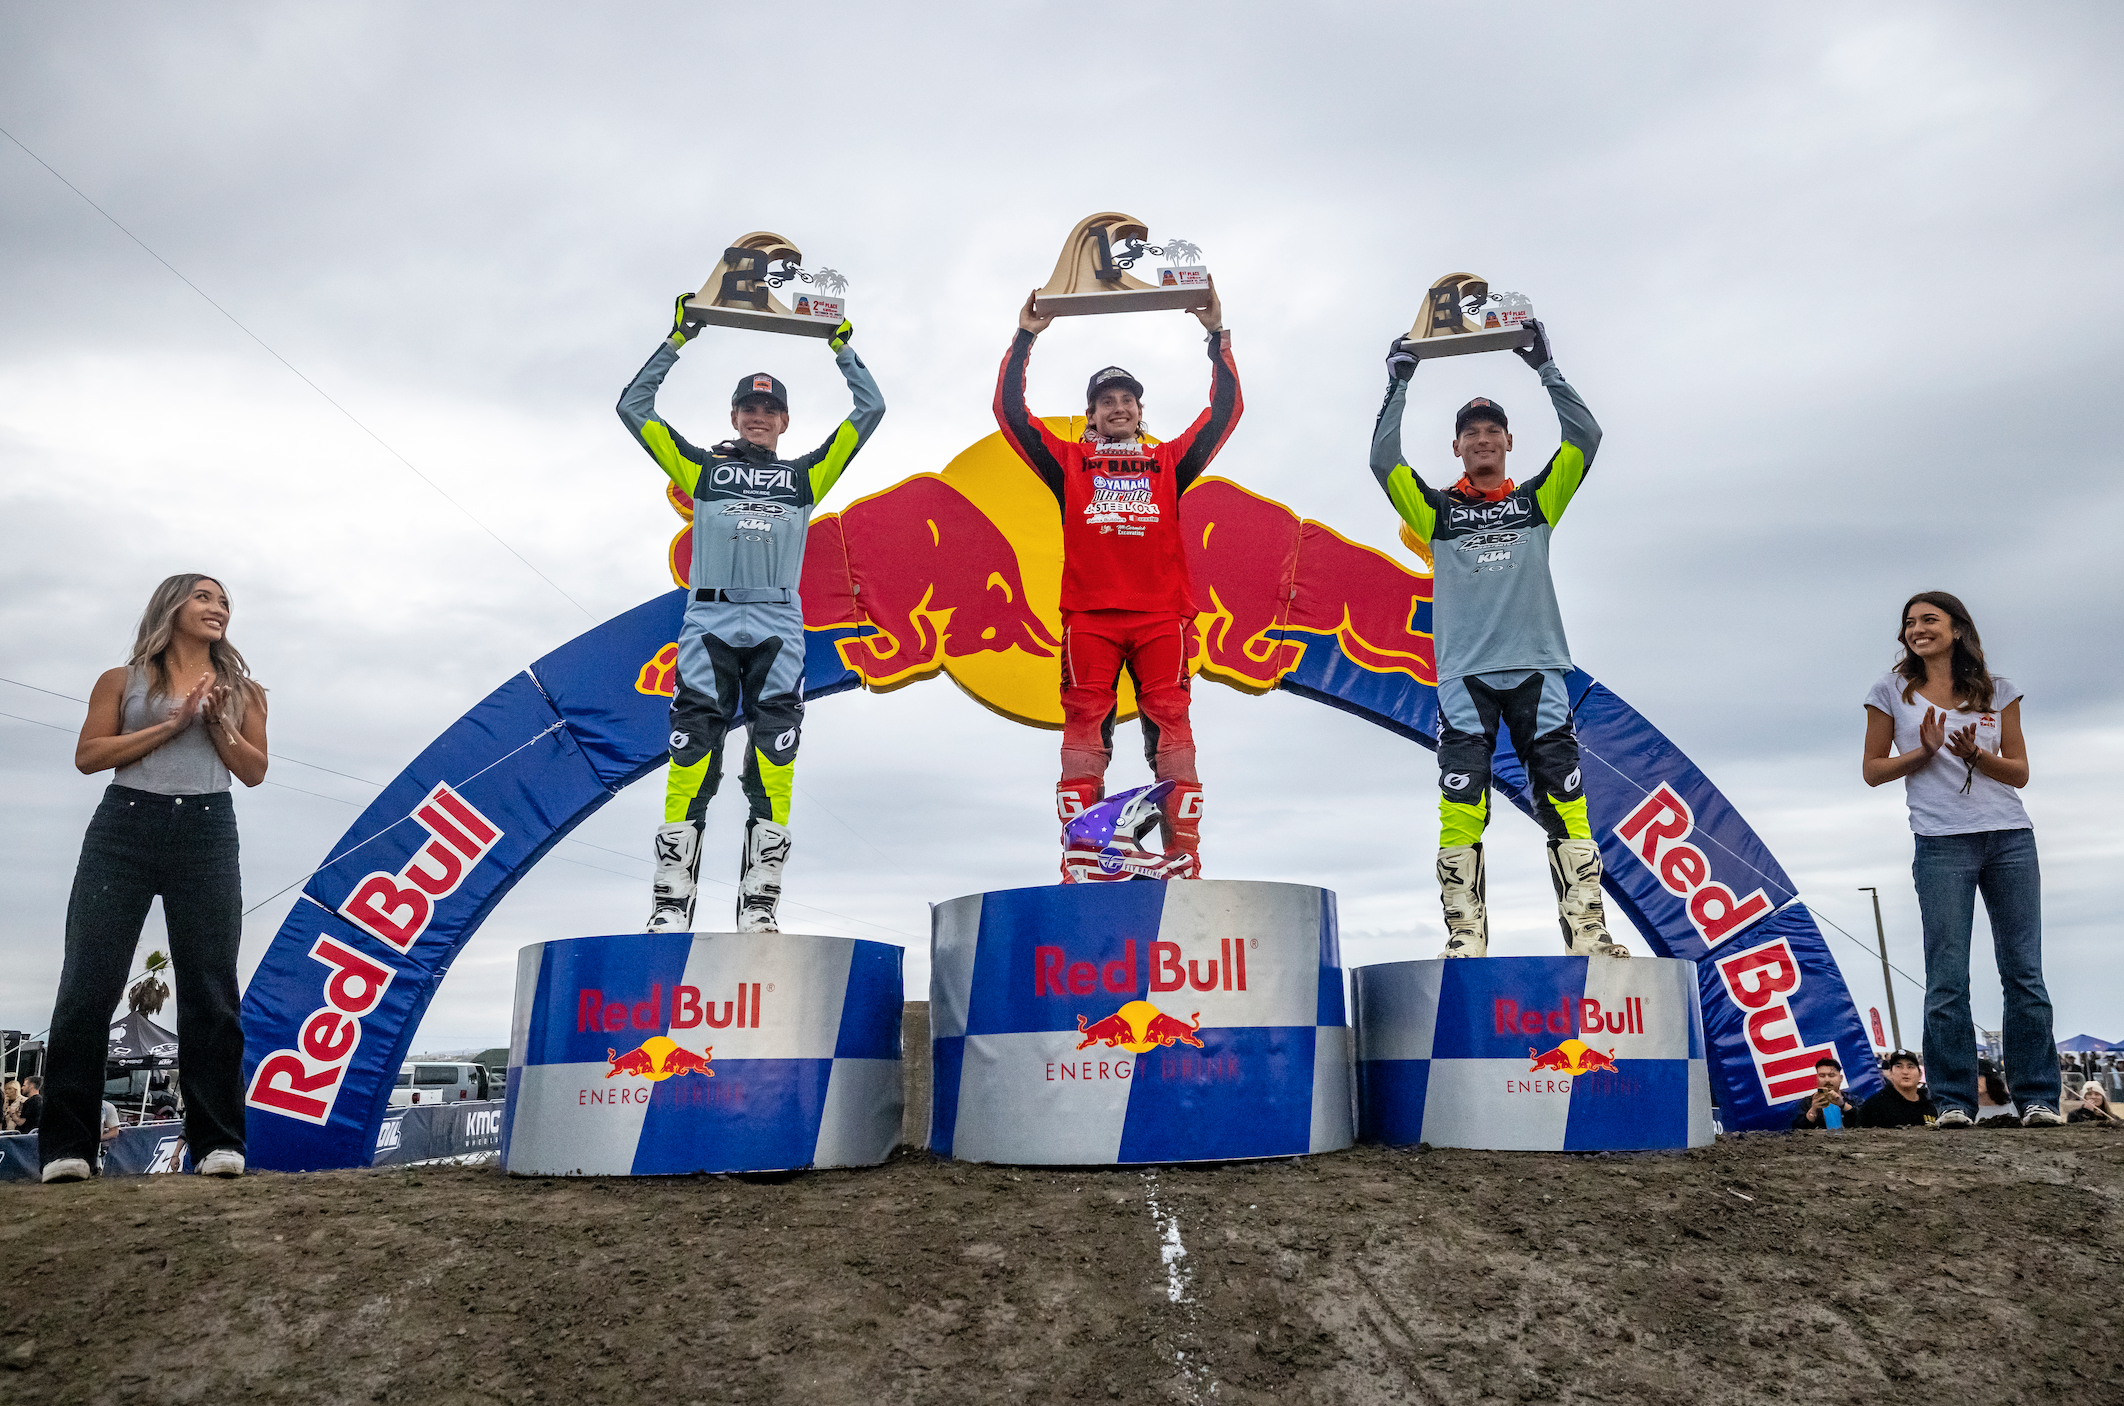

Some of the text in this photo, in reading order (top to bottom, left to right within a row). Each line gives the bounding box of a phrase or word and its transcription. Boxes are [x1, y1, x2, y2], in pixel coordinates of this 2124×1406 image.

[722, 247, 769, 304] 2
[1108, 458, 1160, 473] RACING
[1107, 478, 1151, 490] YAMAHA
[736, 518, 773, 532] KTM
[1477, 550, 1511, 563] KTM
[1124, 864, 1161, 878] FLY RACING
[250, 787, 498, 1119] Red Bull
[1619, 787, 1836, 1100] Red Bull
[1035, 938, 1247, 997] Red Bull
[577, 983, 761, 1033] Red Bull
[1494, 997, 1644, 1035] Red Bull
[1161, 1059, 1239, 1079] DRINK
[466, 1110, 500, 1136] KMC
[466, 1137, 499, 1147] WHEELS
